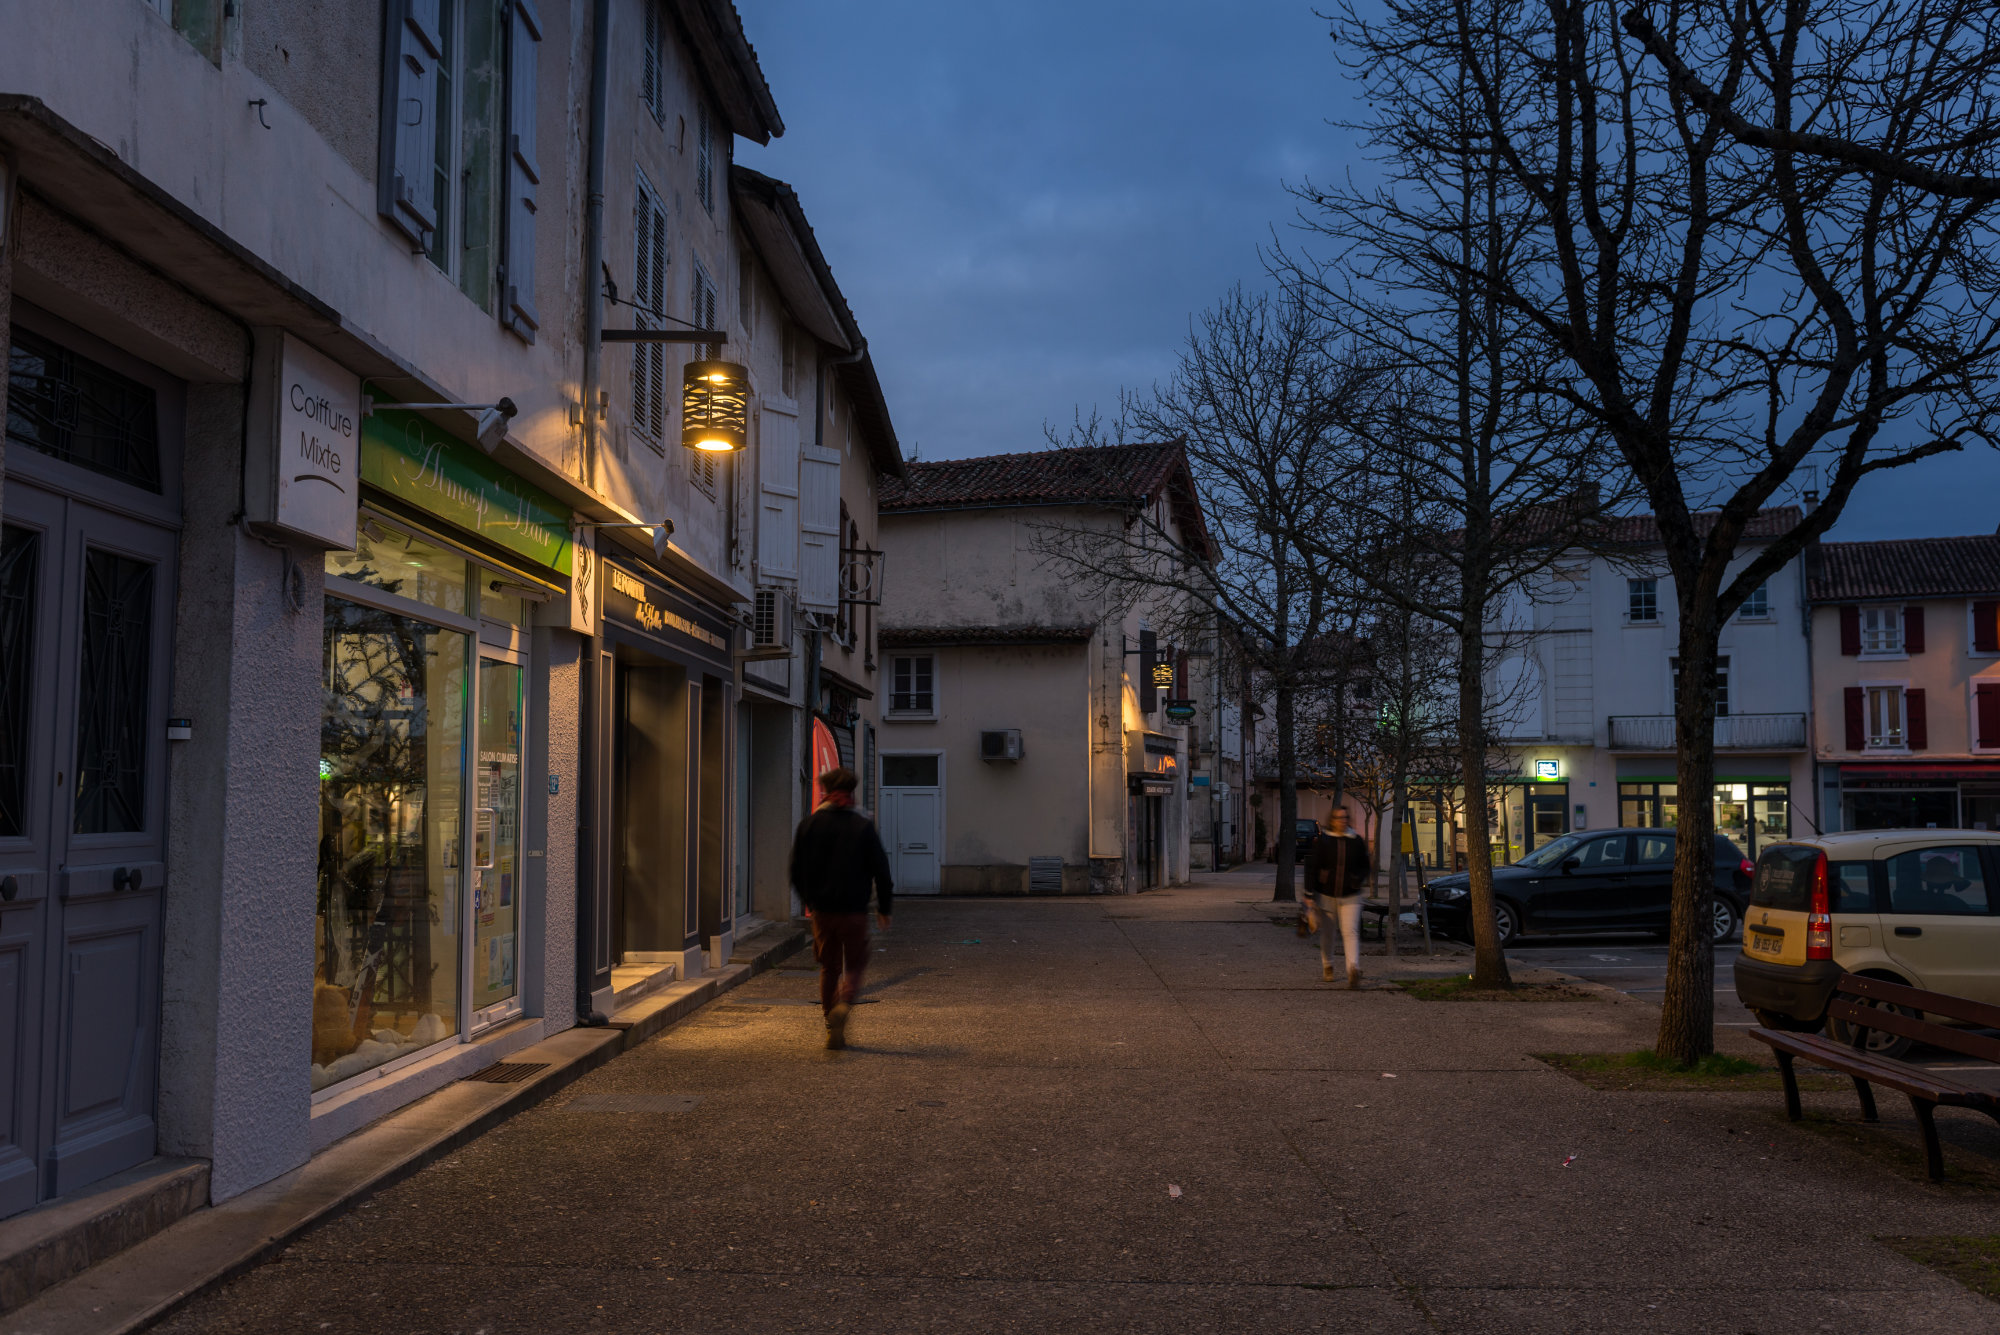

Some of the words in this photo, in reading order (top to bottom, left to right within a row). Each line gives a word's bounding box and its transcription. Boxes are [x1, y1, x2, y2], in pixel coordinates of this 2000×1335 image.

[290, 383, 352, 438] Coiffure
[300, 431, 341, 474] Mixte
[480, 751, 496, 762] SALON
